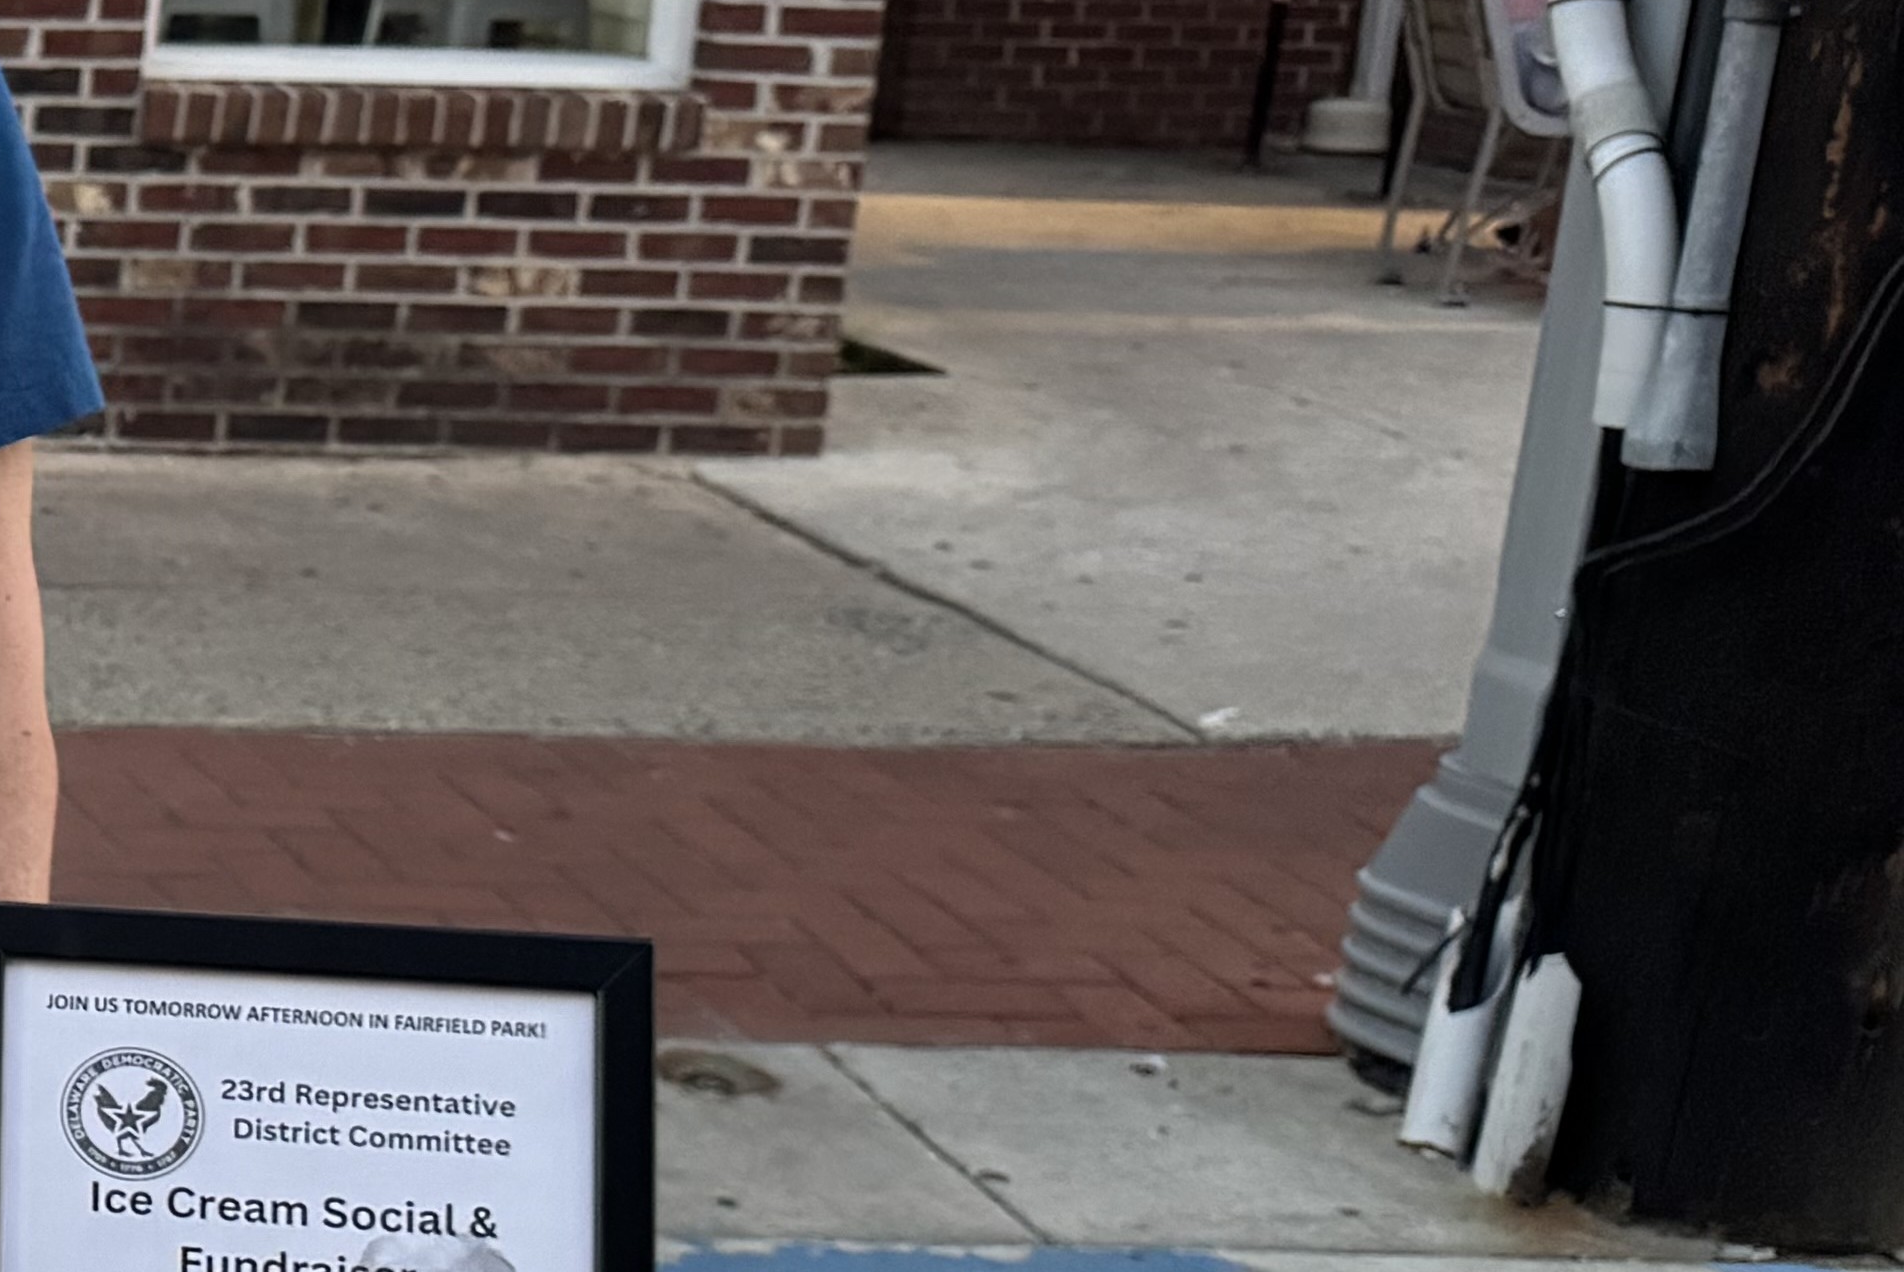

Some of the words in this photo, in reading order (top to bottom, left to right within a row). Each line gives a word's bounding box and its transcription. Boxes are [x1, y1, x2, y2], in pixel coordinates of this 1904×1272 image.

[47, 994, 89, 1012] JOIN
[94, 997, 118, 1013] US
[124, 998, 242, 1021] TOMORROW
[246, 1007, 364, 1028] AFTERNOON
[369, 1013, 389, 1030] IN
[395, 1014, 486, 1035] FAIRFIELD
[491, 1020, 546, 1039] PARK!
[68, 1067, 98, 1140] DELAWARE
[102, 1054, 189, 1095] DEMOCRATIC
[221, 1079, 286, 1104] 23rd
[295, 1083, 516, 1117] Representative
[234, 1118, 340, 1146] District
[348, 1126, 511, 1156] Committee
[91, 1181, 152, 1216] Ice
[167, 1187, 308, 1227] Cream
[323, 1197, 455, 1237] Social
[469, 1206, 497, 1239] &
